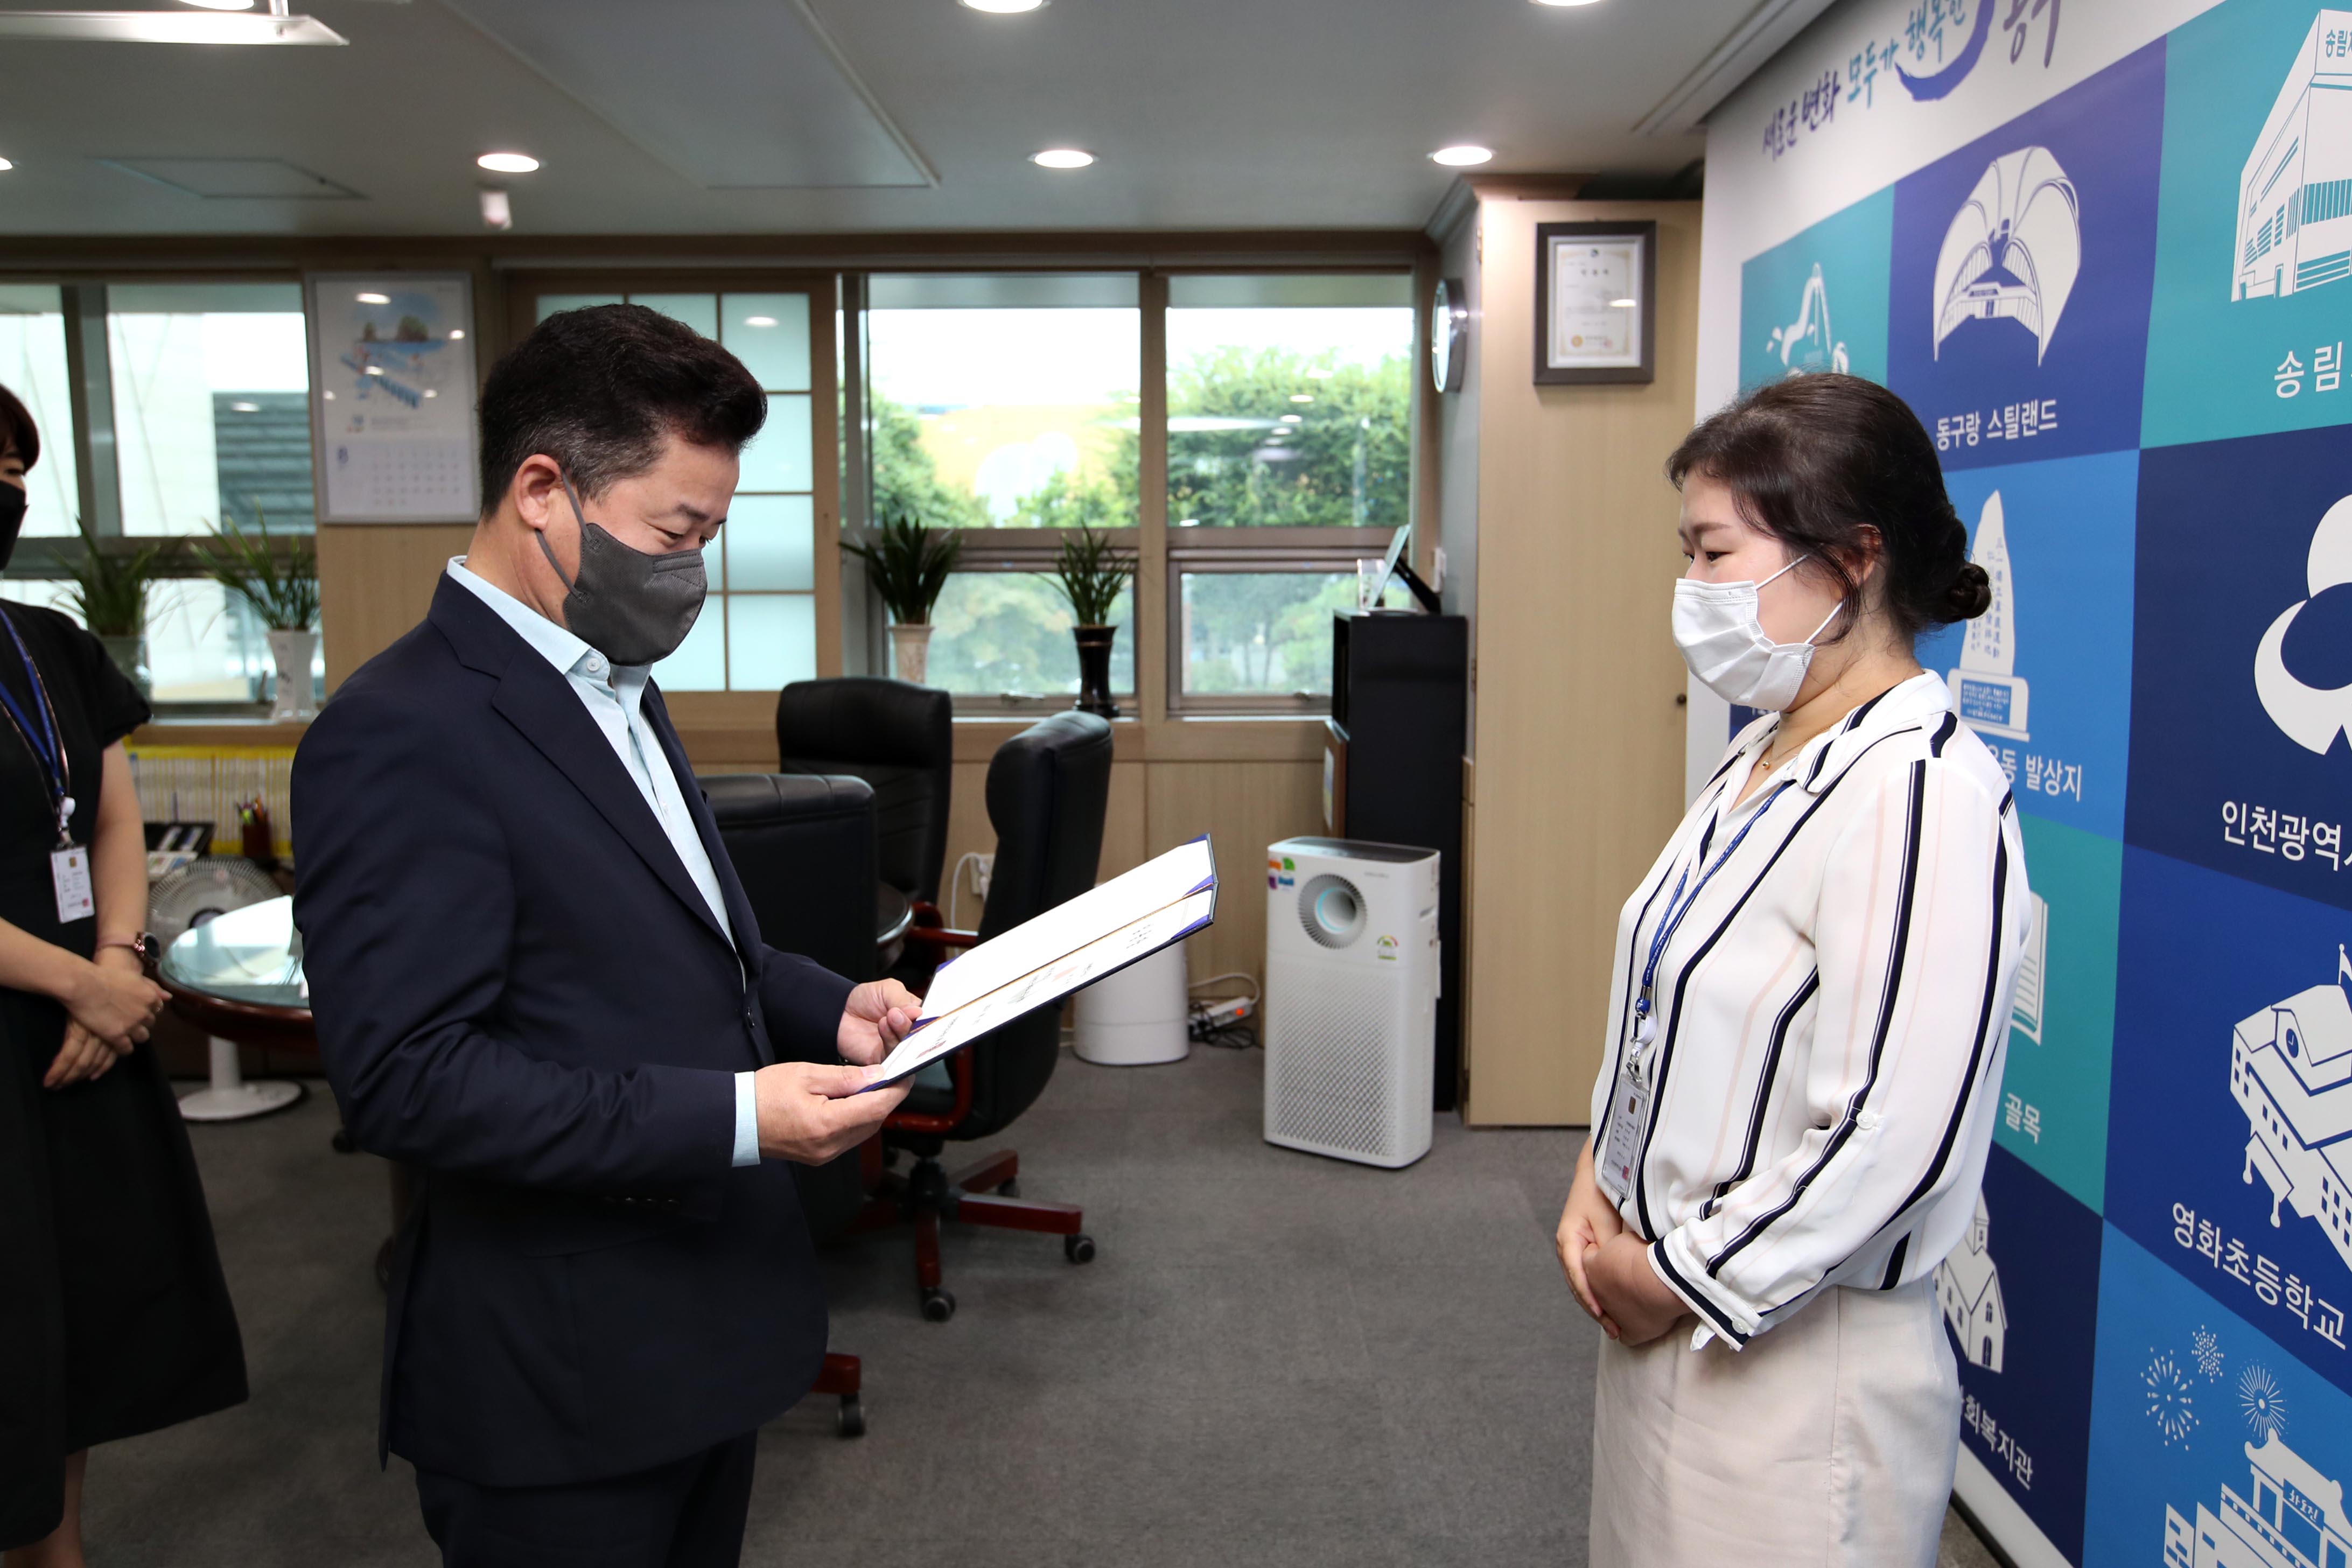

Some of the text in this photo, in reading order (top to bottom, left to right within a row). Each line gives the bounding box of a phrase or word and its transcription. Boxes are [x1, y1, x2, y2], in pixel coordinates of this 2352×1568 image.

[2326, 29, 2352, 58] 송림
[1762, 100, 1798, 160] 새로운
[1802, 71, 1840, 131] 변화
[1847, 39, 1899, 109] 모두가
[1936, 399, 2058, 451] 동구랑 스틸랜드
[2025, 753, 2082, 802] 발상지
[2004, 1092, 2041, 1145] 골목
[2172, 1202, 2346, 1350] 영화초등학교
